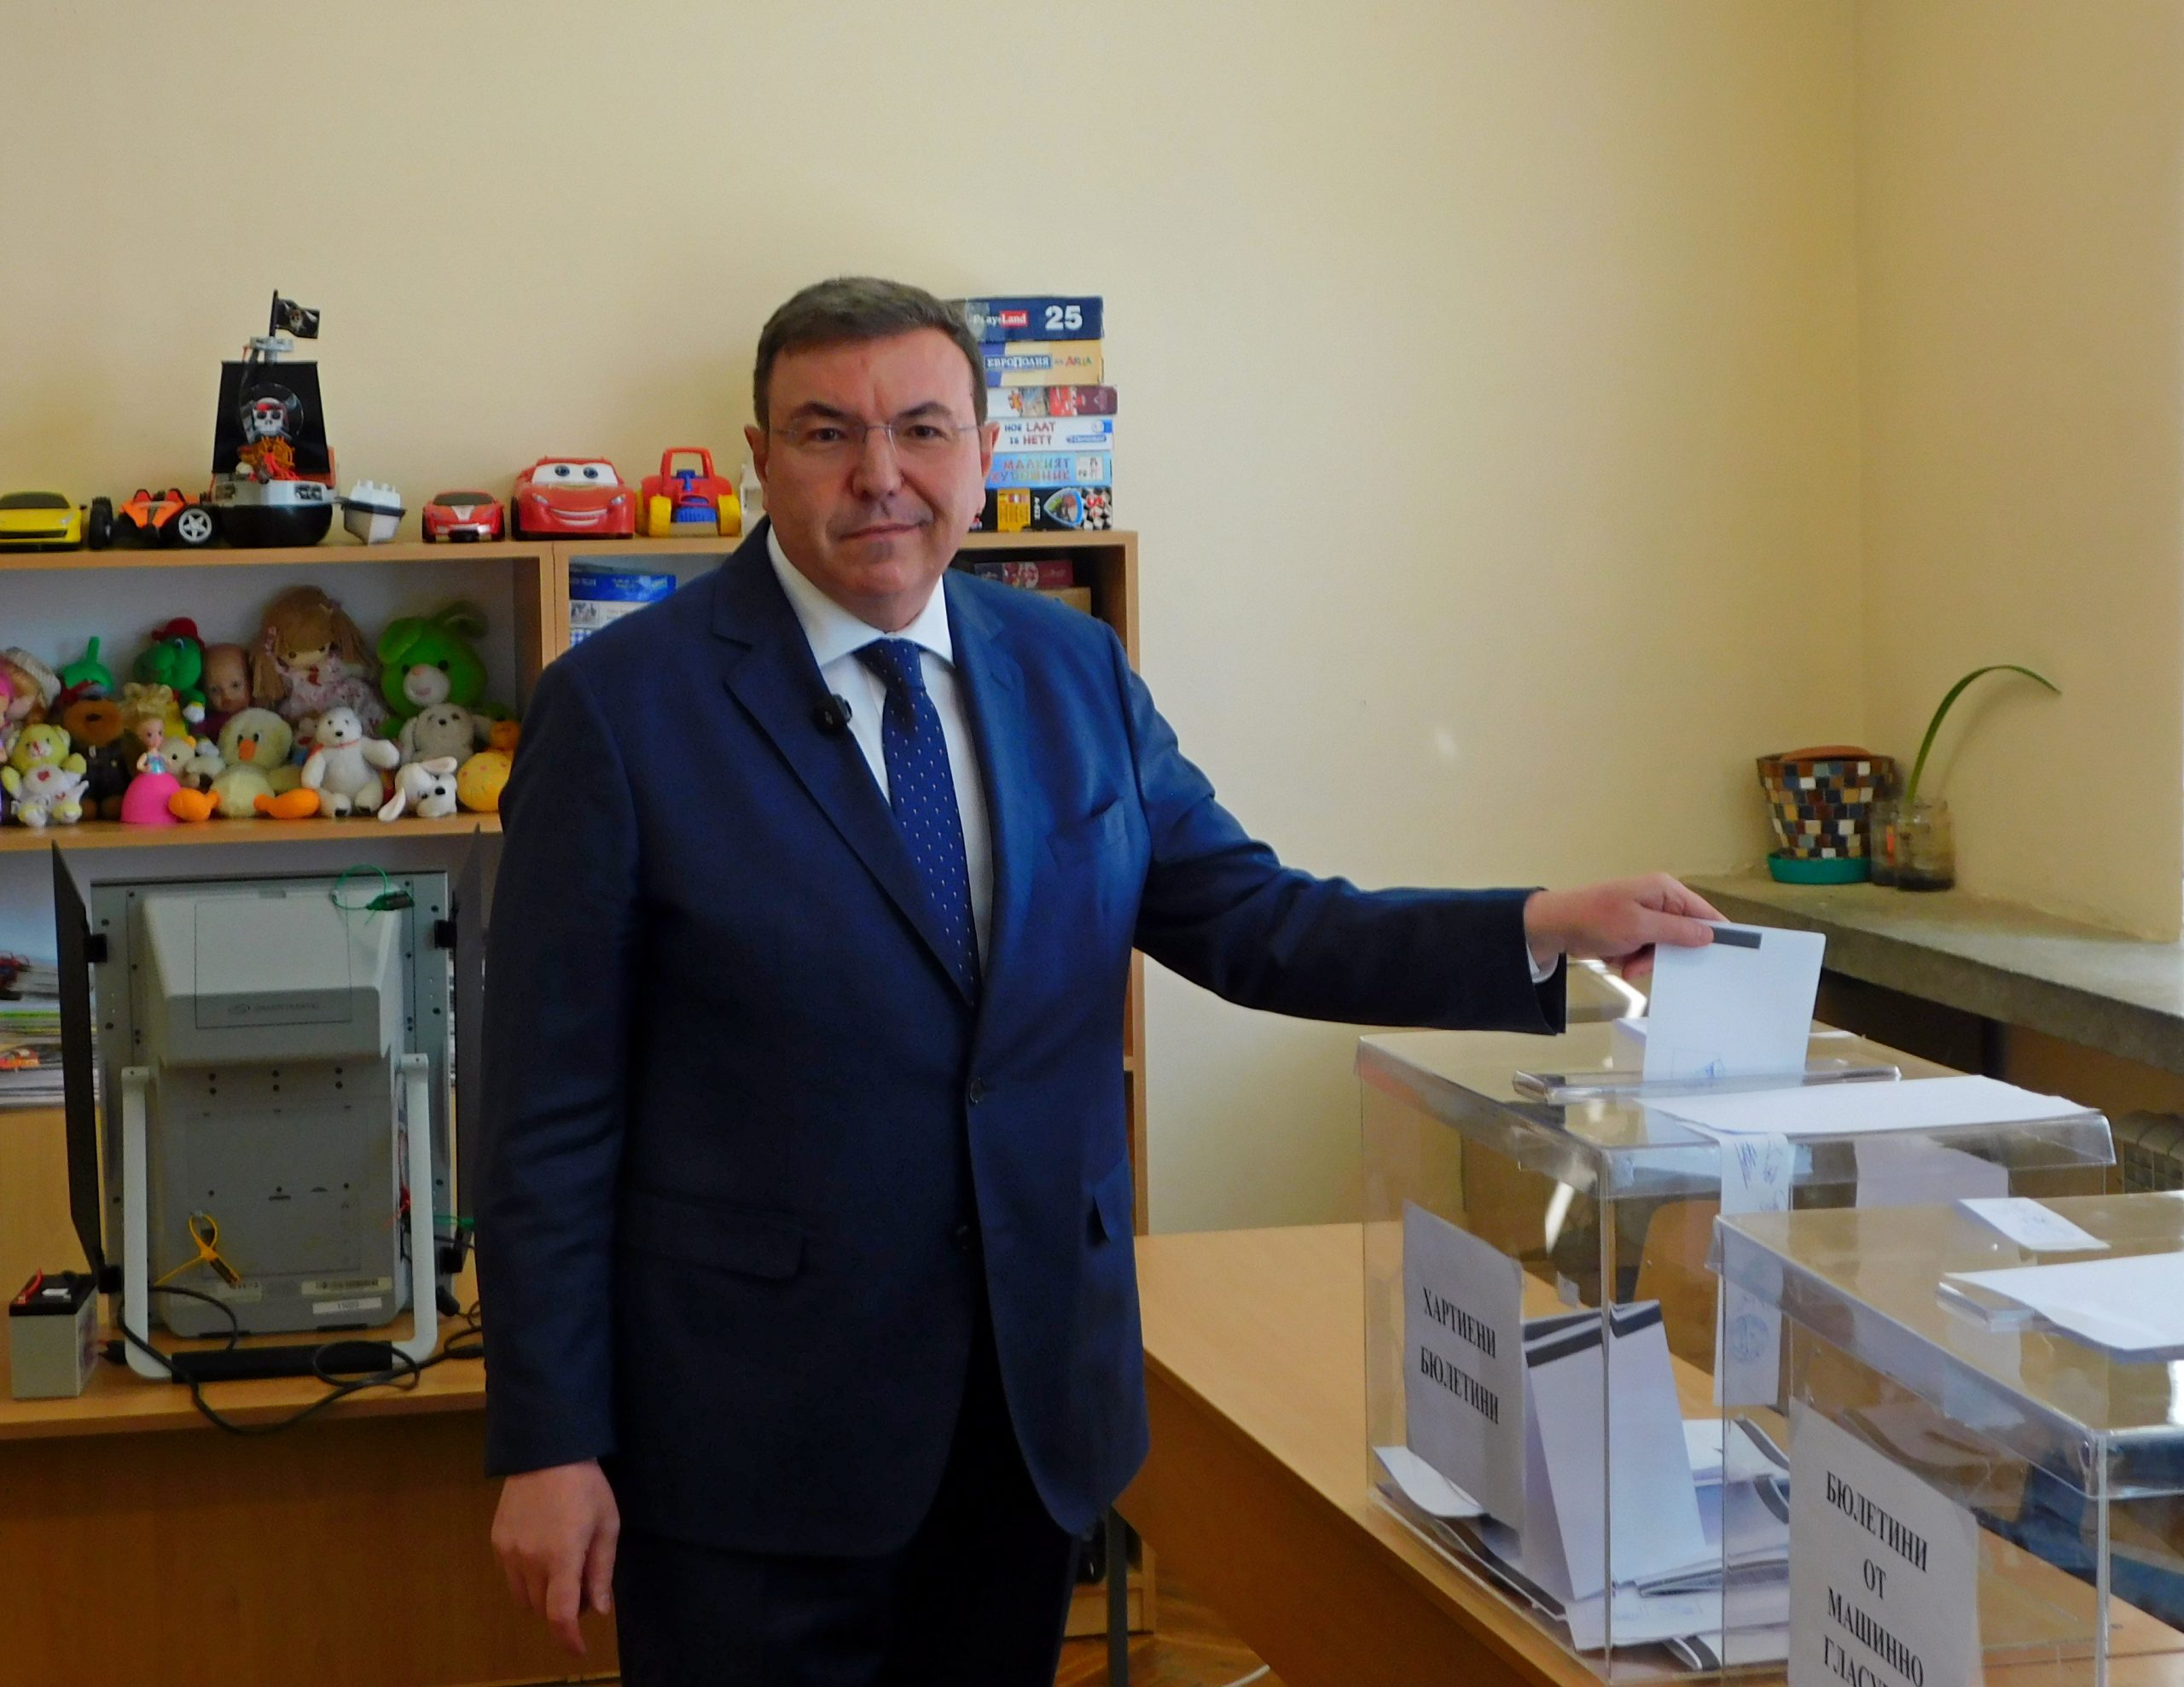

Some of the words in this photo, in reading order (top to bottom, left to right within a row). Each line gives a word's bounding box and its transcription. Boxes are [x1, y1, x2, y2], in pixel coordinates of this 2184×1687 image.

[1045, 305, 1083, 330] 25
[1026, 422, 1055, 432] LAAT
[1423, 1286, 1496, 1358] ХАРТИЕНИ
[1420, 1345, 1499, 1424] БЮЛЕТИНИ
[1827, 1470, 1927, 1573] БЮЛЕТИНИ
[1863, 1558, 1886, 1599] ОТ
[1828, 1585, 1924, 1687] МАШИННО
